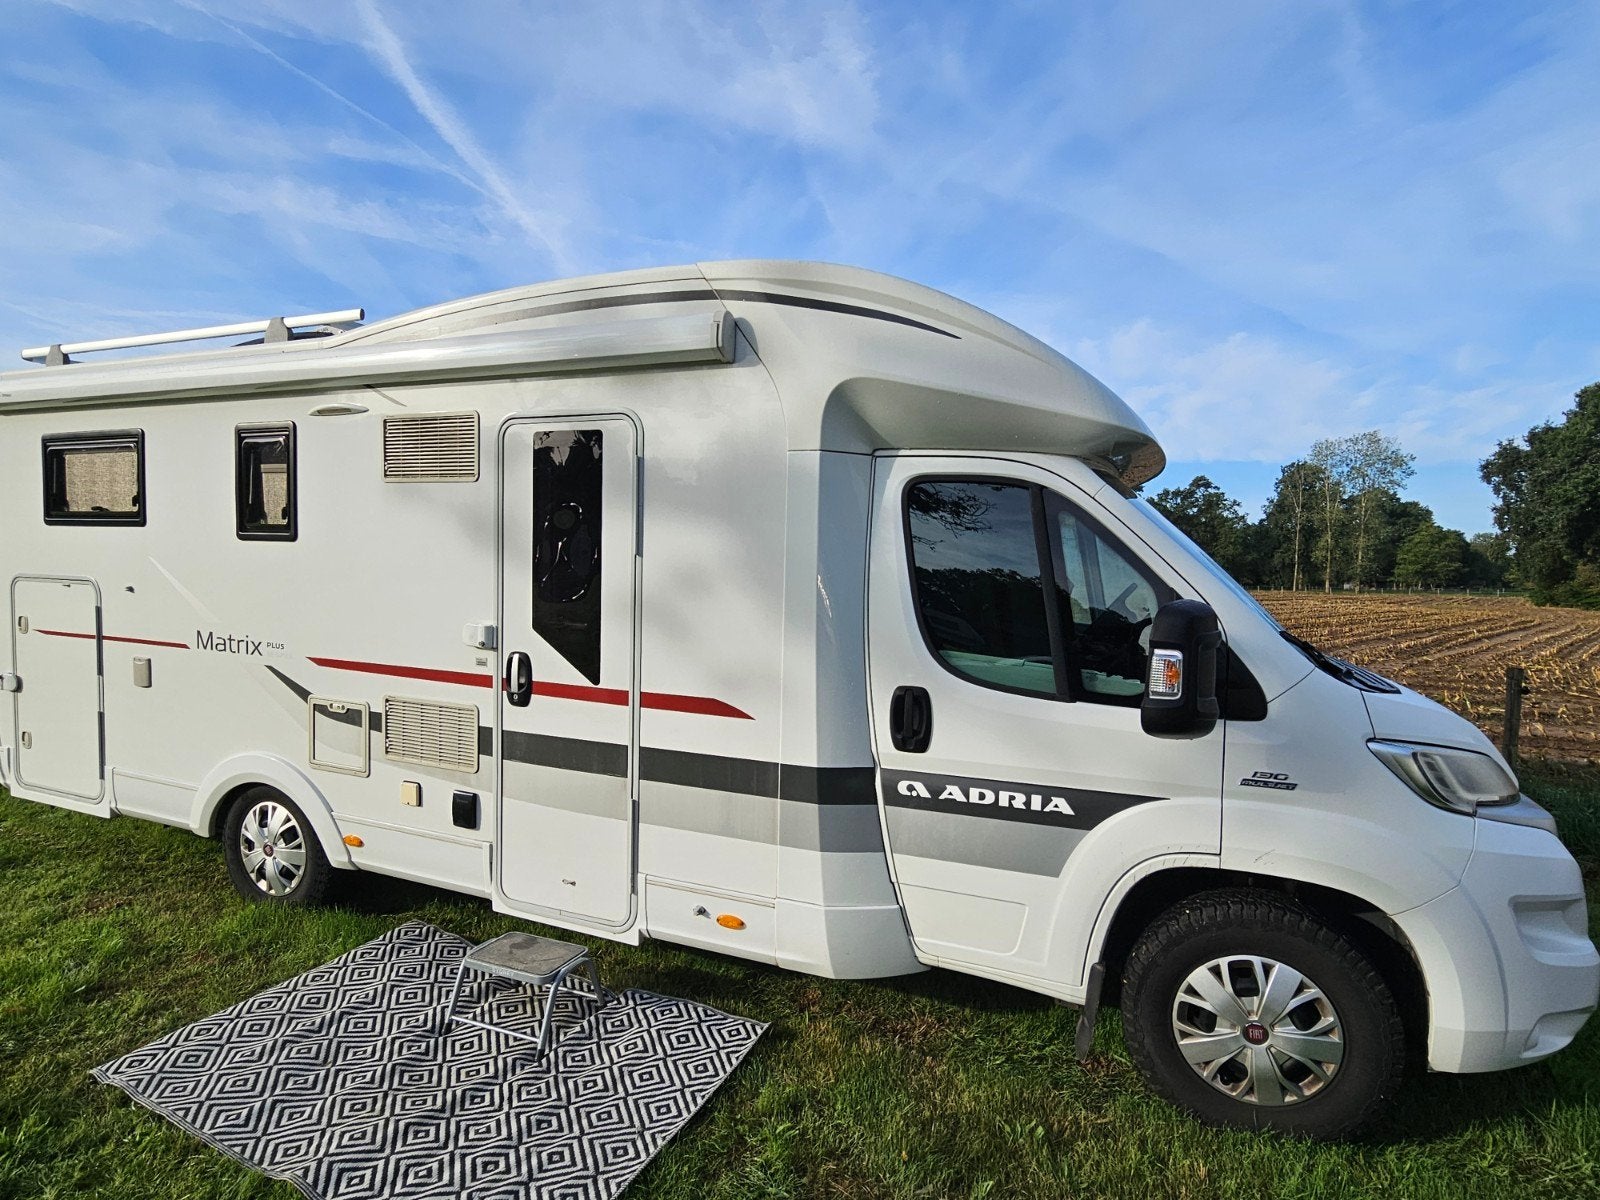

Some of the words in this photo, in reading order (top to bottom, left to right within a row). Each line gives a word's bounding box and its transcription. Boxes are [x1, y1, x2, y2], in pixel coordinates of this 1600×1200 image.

[196, 630, 263, 656] Matrix
[266, 642, 285, 650] PLUS
[938, 784, 1076, 816] ADRIA
[1249, 1029, 1264, 1039] FIAT
